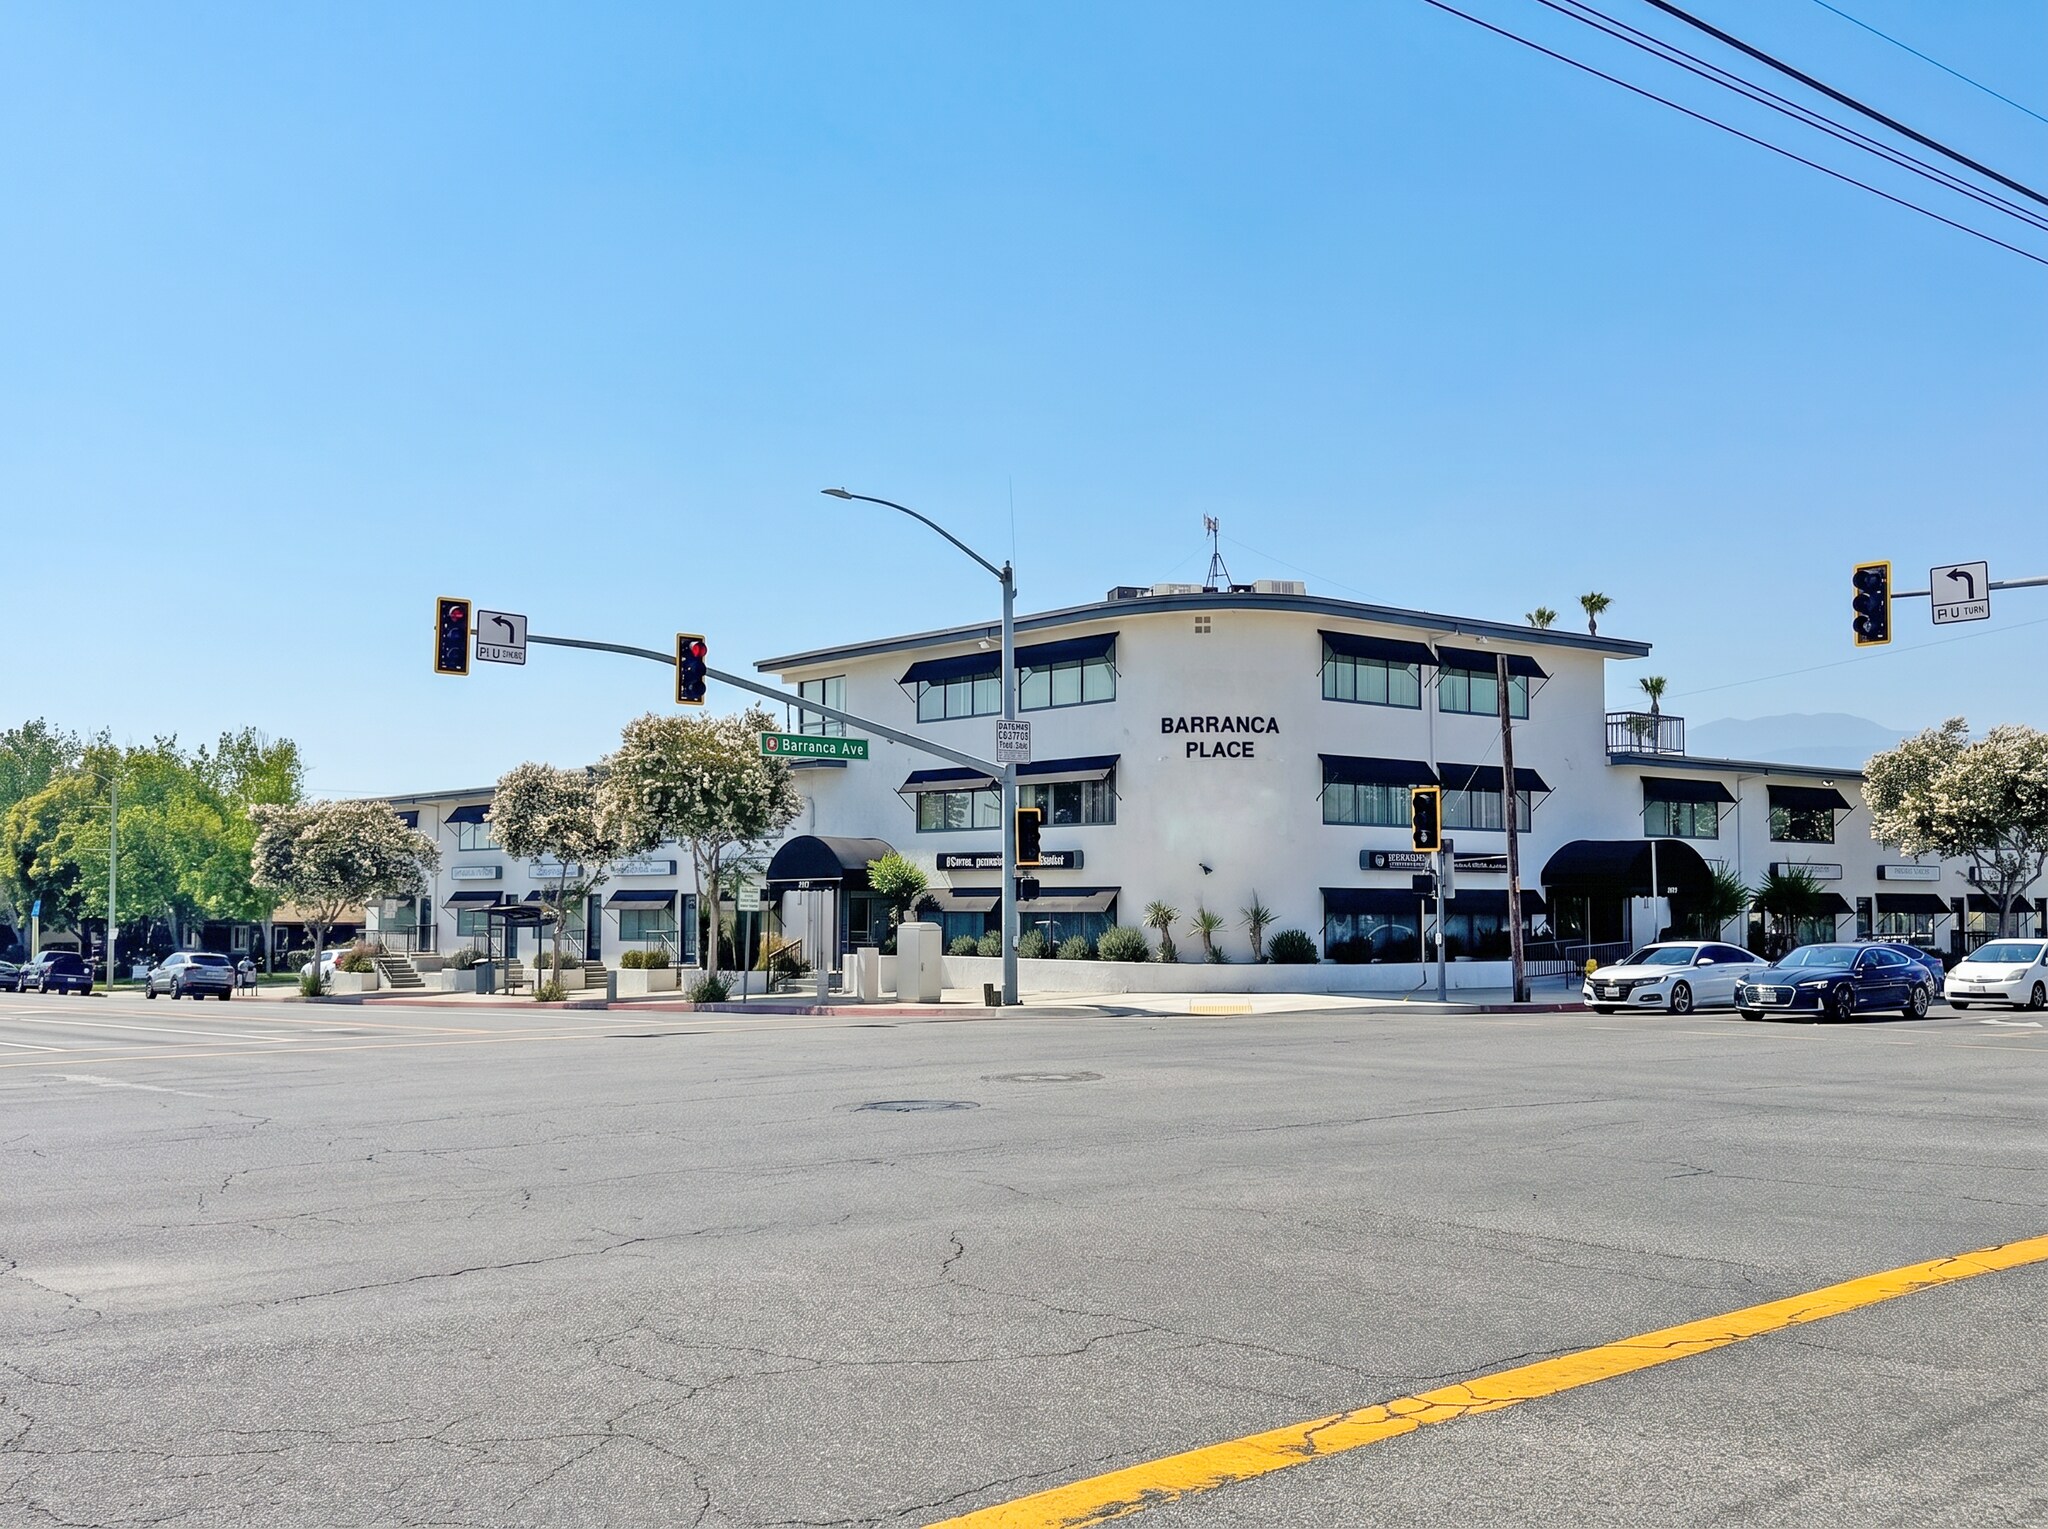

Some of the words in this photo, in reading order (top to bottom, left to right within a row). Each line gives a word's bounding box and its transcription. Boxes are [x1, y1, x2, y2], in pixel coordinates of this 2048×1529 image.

[1963, 605, 1985, 616] TURN
[1161, 716, 1280, 734] BARRANCA
[782, 738, 836, 754] Barranca
[841, 742, 864, 756] Ave
[1186, 741, 1255, 758] PLACE
